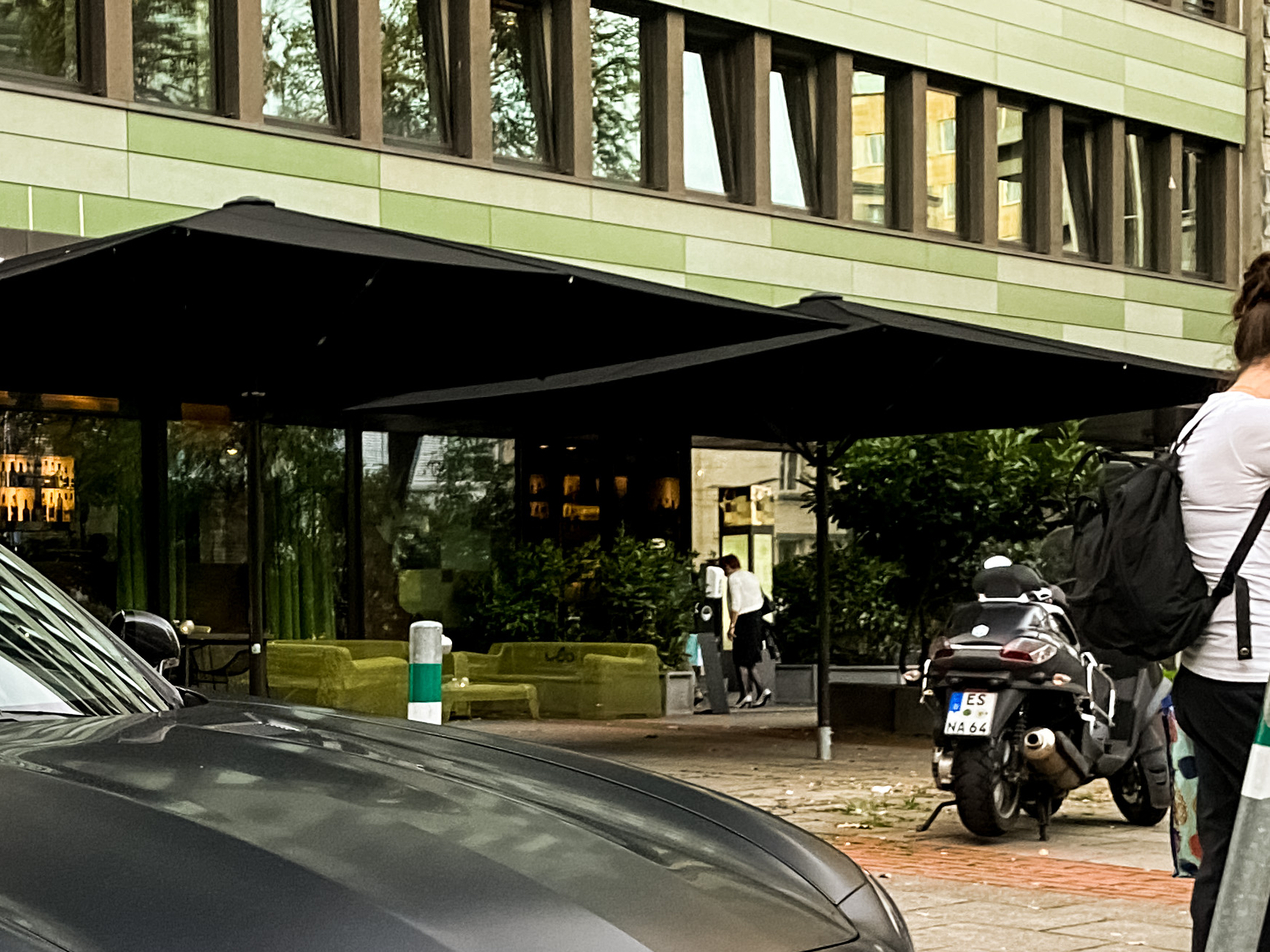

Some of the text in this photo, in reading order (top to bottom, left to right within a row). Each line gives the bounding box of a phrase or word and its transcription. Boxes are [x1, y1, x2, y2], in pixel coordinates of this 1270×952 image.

[966, 693, 986, 706] ES
[946, 721, 987, 733] NA 64
